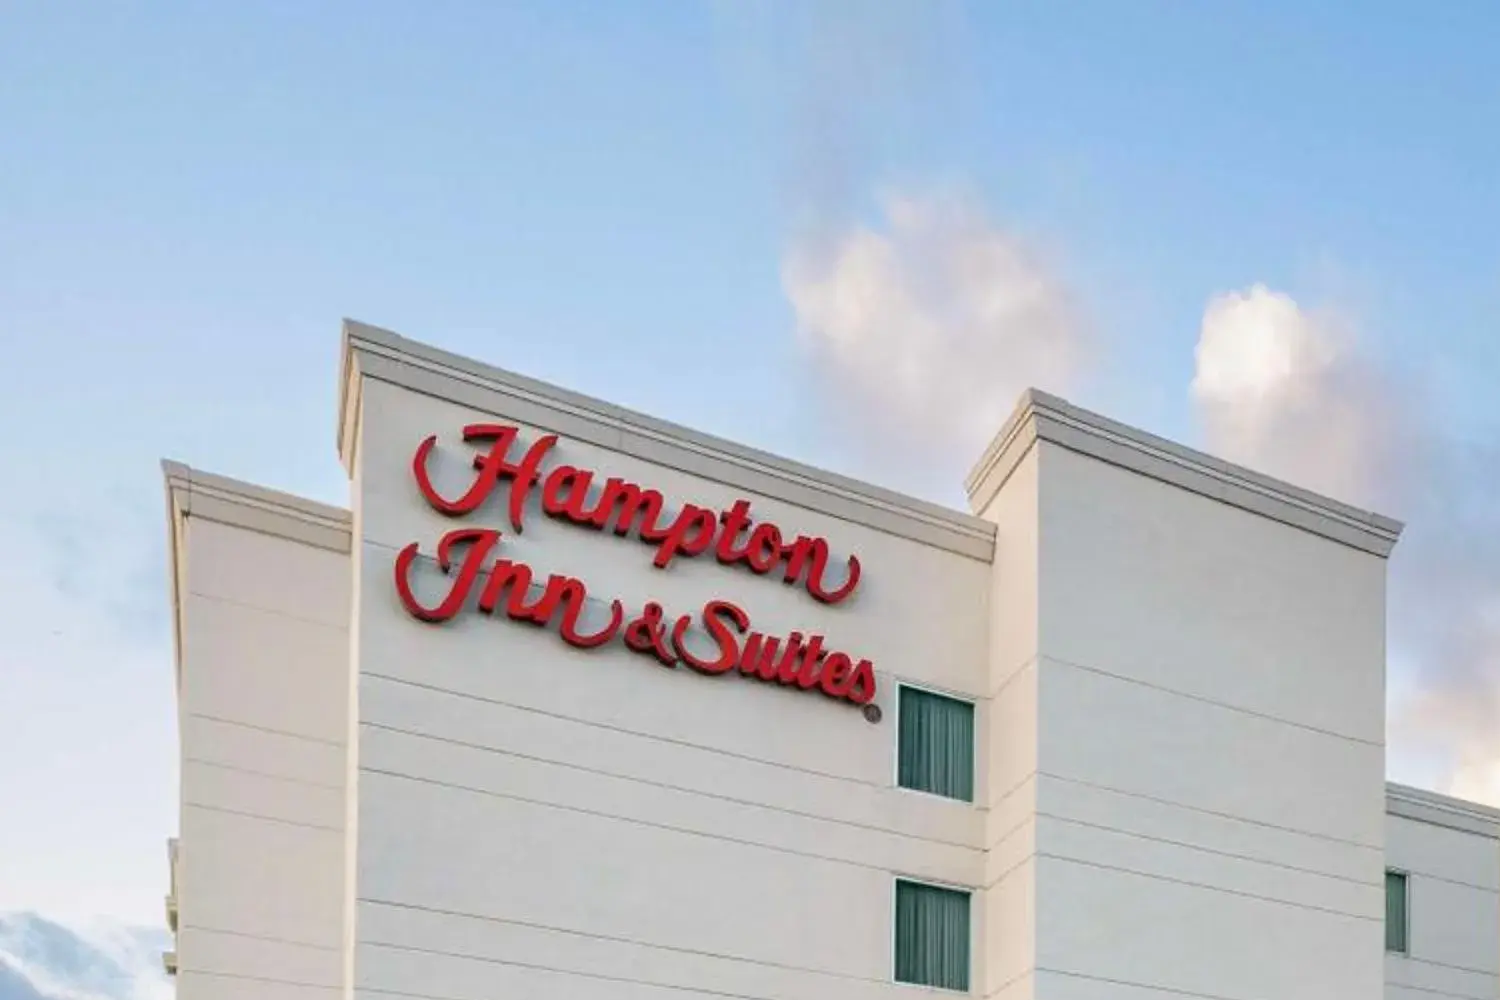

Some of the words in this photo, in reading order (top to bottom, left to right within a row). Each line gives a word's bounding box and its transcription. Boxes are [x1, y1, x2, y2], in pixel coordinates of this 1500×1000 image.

[413, 422, 861, 605] Hampton
[395, 527, 624, 649] Inn
[672, 600, 877, 705] Suites
